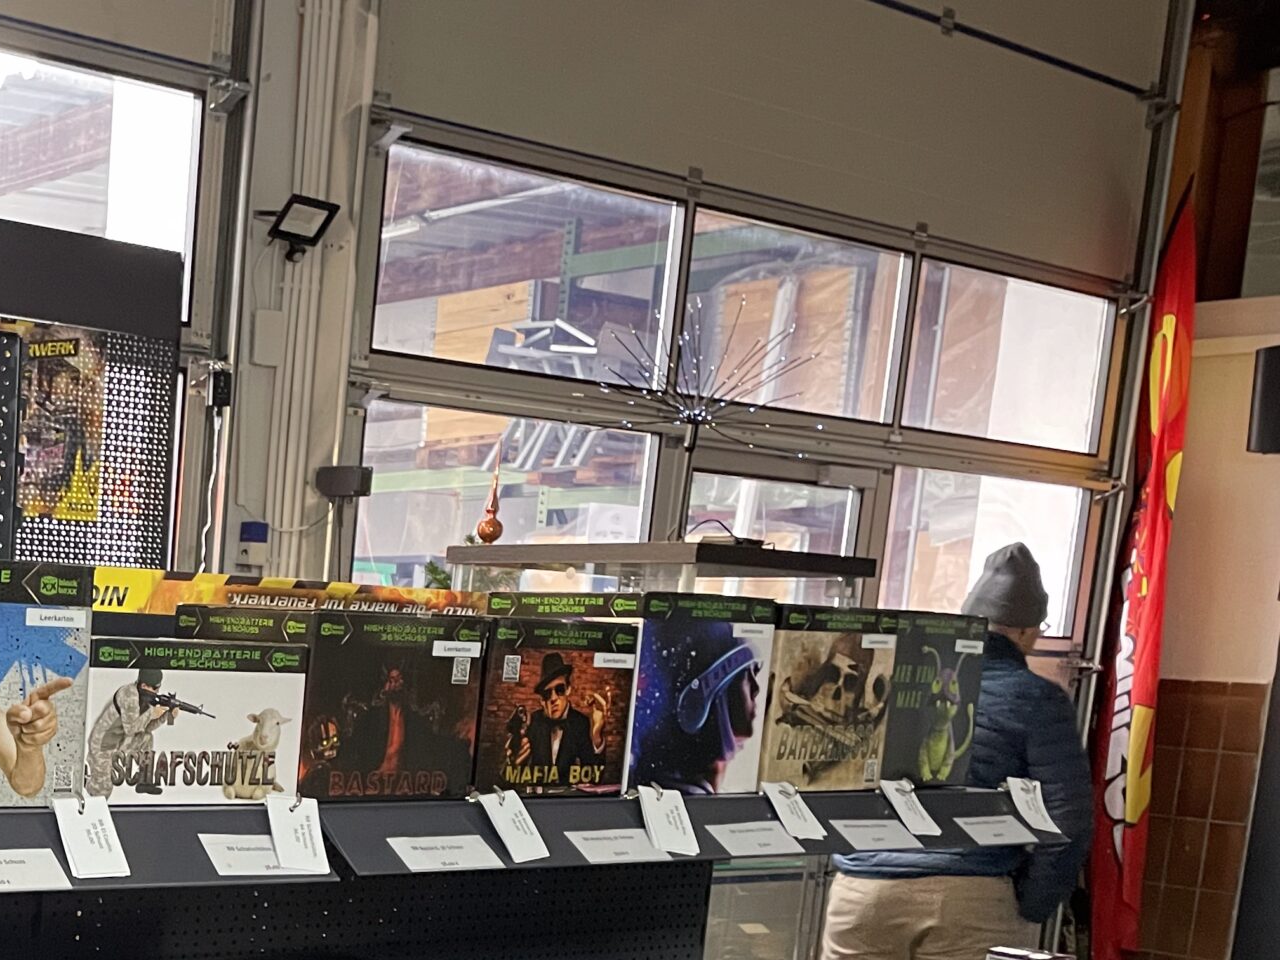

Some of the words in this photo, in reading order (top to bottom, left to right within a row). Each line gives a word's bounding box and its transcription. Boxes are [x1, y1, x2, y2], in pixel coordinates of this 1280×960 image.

[39, 613, 75, 624] Leerkarton
[144, 646, 201, 659] HIGH-END
[204, 648, 261, 661] BATTERIE
[188, 660, 237, 670] SCHUSS
[111, 741, 277, 787] SCHAFSCHÜTZE
[506, 764, 560, 785] MAFIA
[568, 763, 605, 785] BOY
[329, 770, 449, 797] BASTARD
